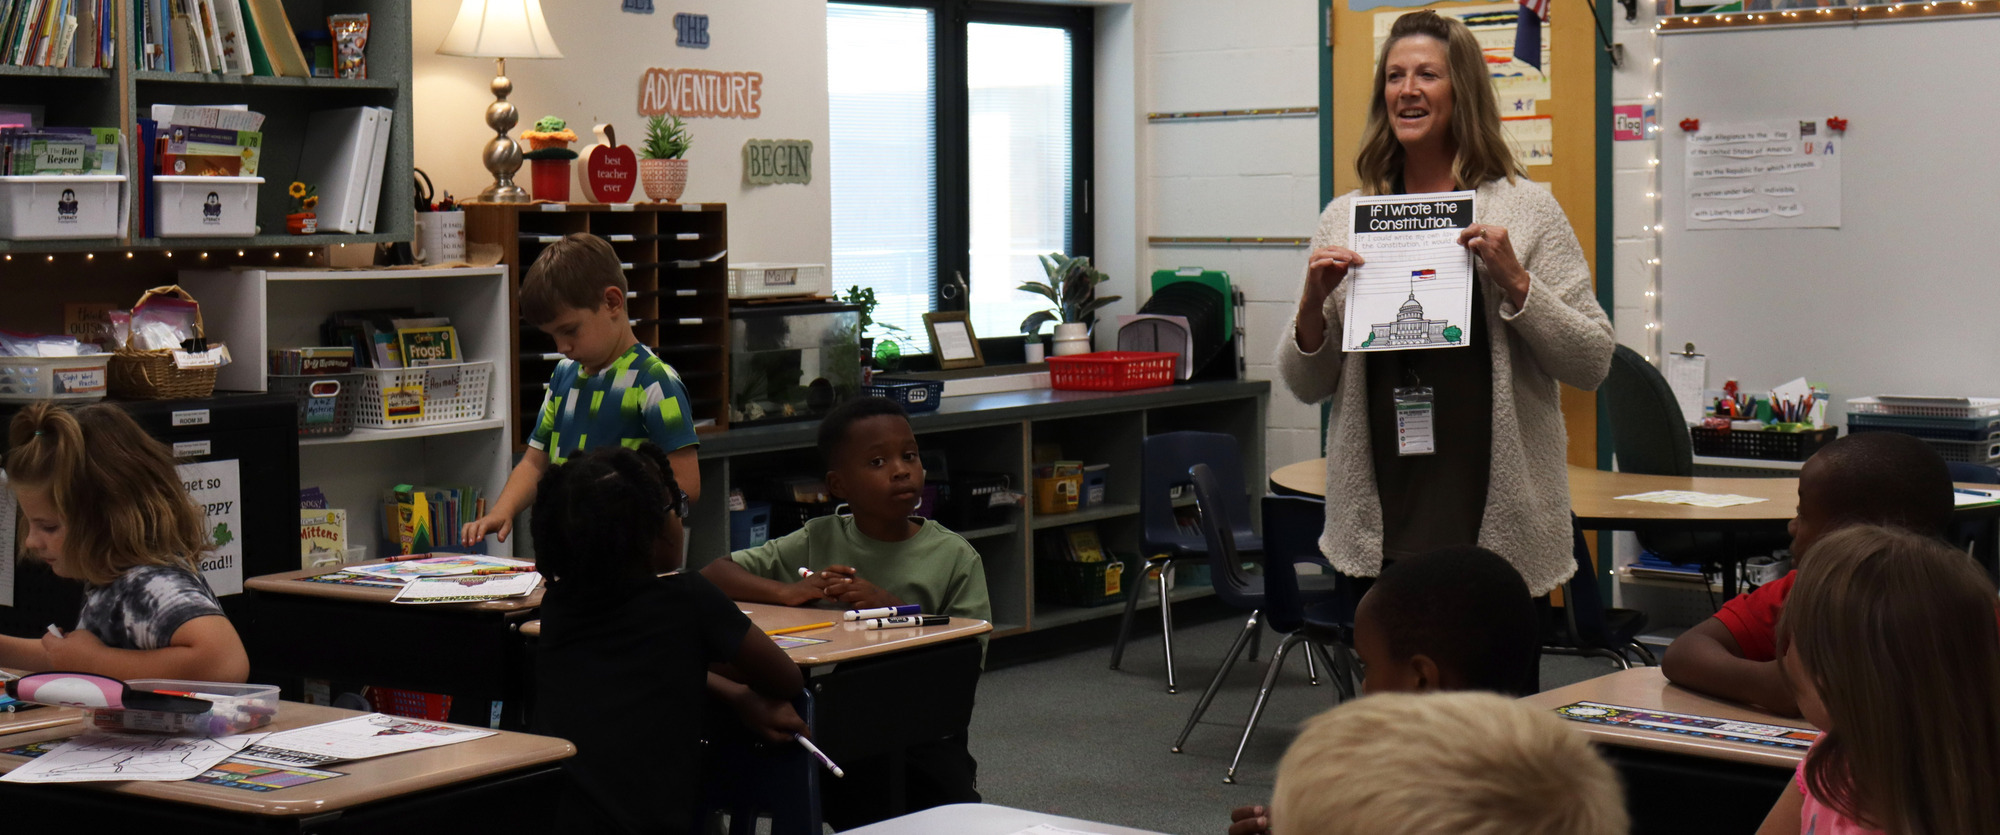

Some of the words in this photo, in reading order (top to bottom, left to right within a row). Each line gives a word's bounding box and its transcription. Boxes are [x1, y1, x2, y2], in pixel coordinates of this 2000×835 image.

[677, 14, 709, 45] THE
[643, 73, 760, 113] ADVENTURE
[1616, 115, 1641, 136] flag
[104, 134, 115, 145] 60
[249, 137, 258, 147] 78
[1715, 132, 1745, 141] Allegiance
[61, 147, 77, 156] Bird
[47, 154, 79, 164] Rescue
[604, 154, 621, 166] best
[749, 144, 809, 178] BEGIN
[597, 168, 628, 180] teacher
[1726, 167, 1752, 176] Republic
[603, 183, 621, 193] ever
[1370, 205, 1383, 217] If
[1391, 203, 1432, 216] Wrote
[1434, 201, 1458, 214] the
[1709, 209, 1732, 217] Liberty
[1746, 206, 1769, 215] Justice
[1789, 203, 1798, 211] all
[1373, 233, 1391, 241] could
[1394, 232, 1413, 240] write
[1415, 234, 1425, 242] my
[1362, 242, 1374, 250] the
[1423, 239, 1429, 247] it
[767, 269, 788, 283] Mail
[409, 342, 446, 359] Frogs!
[62, 374, 78, 383] Sight
[429, 378, 459, 391] Animals
[308, 405, 334, 414] Mysteries
[183, 479, 204, 494] get
[206, 478, 221, 489] so
[304, 517, 313, 525] Can
[300, 526, 338, 541] Mittens
[201, 555, 233, 572] ead!!
